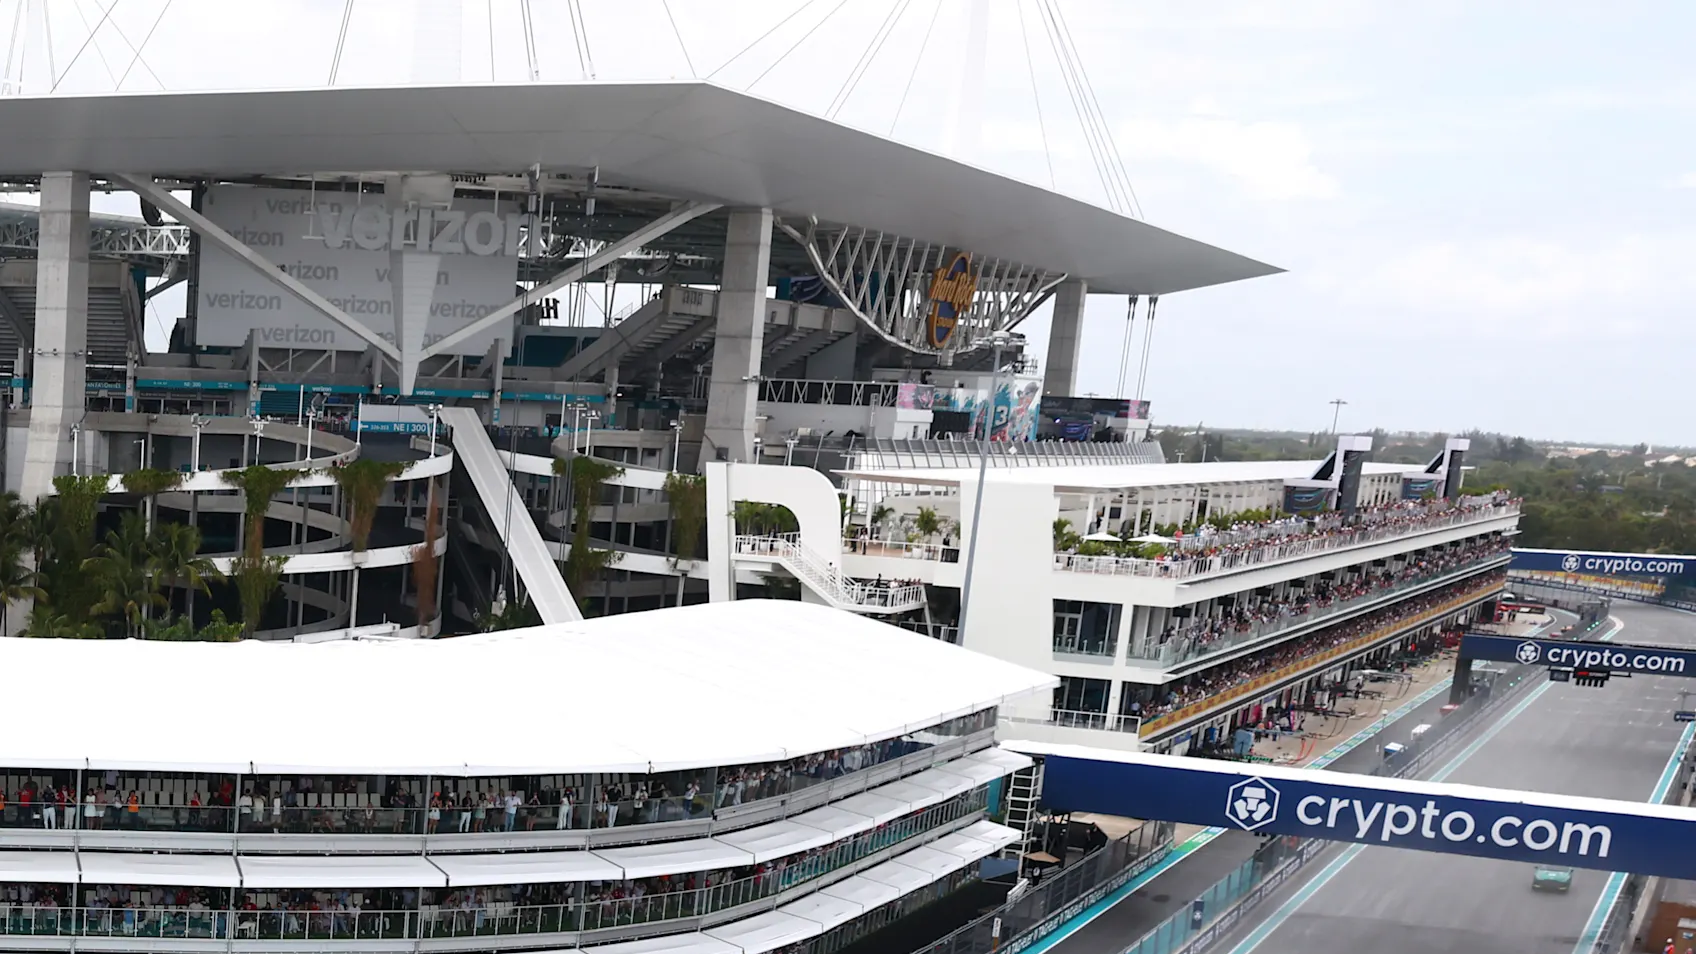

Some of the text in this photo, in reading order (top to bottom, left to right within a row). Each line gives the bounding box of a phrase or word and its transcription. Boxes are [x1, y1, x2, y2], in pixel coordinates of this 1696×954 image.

[266, 197, 342, 215] verin
[226, 227, 284, 247] rizon
[318, 203, 542, 258] verizon
[284, 261, 338, 280] rizon
[206, 290, 281, 310] verizon
[261, 324, 335, 343] verizon
[1585, 558, 1684, 574] crypto.com
[1547, 646, 1685, 673] crypto.com
[1296, 795, 1611, 859] crypto.com
